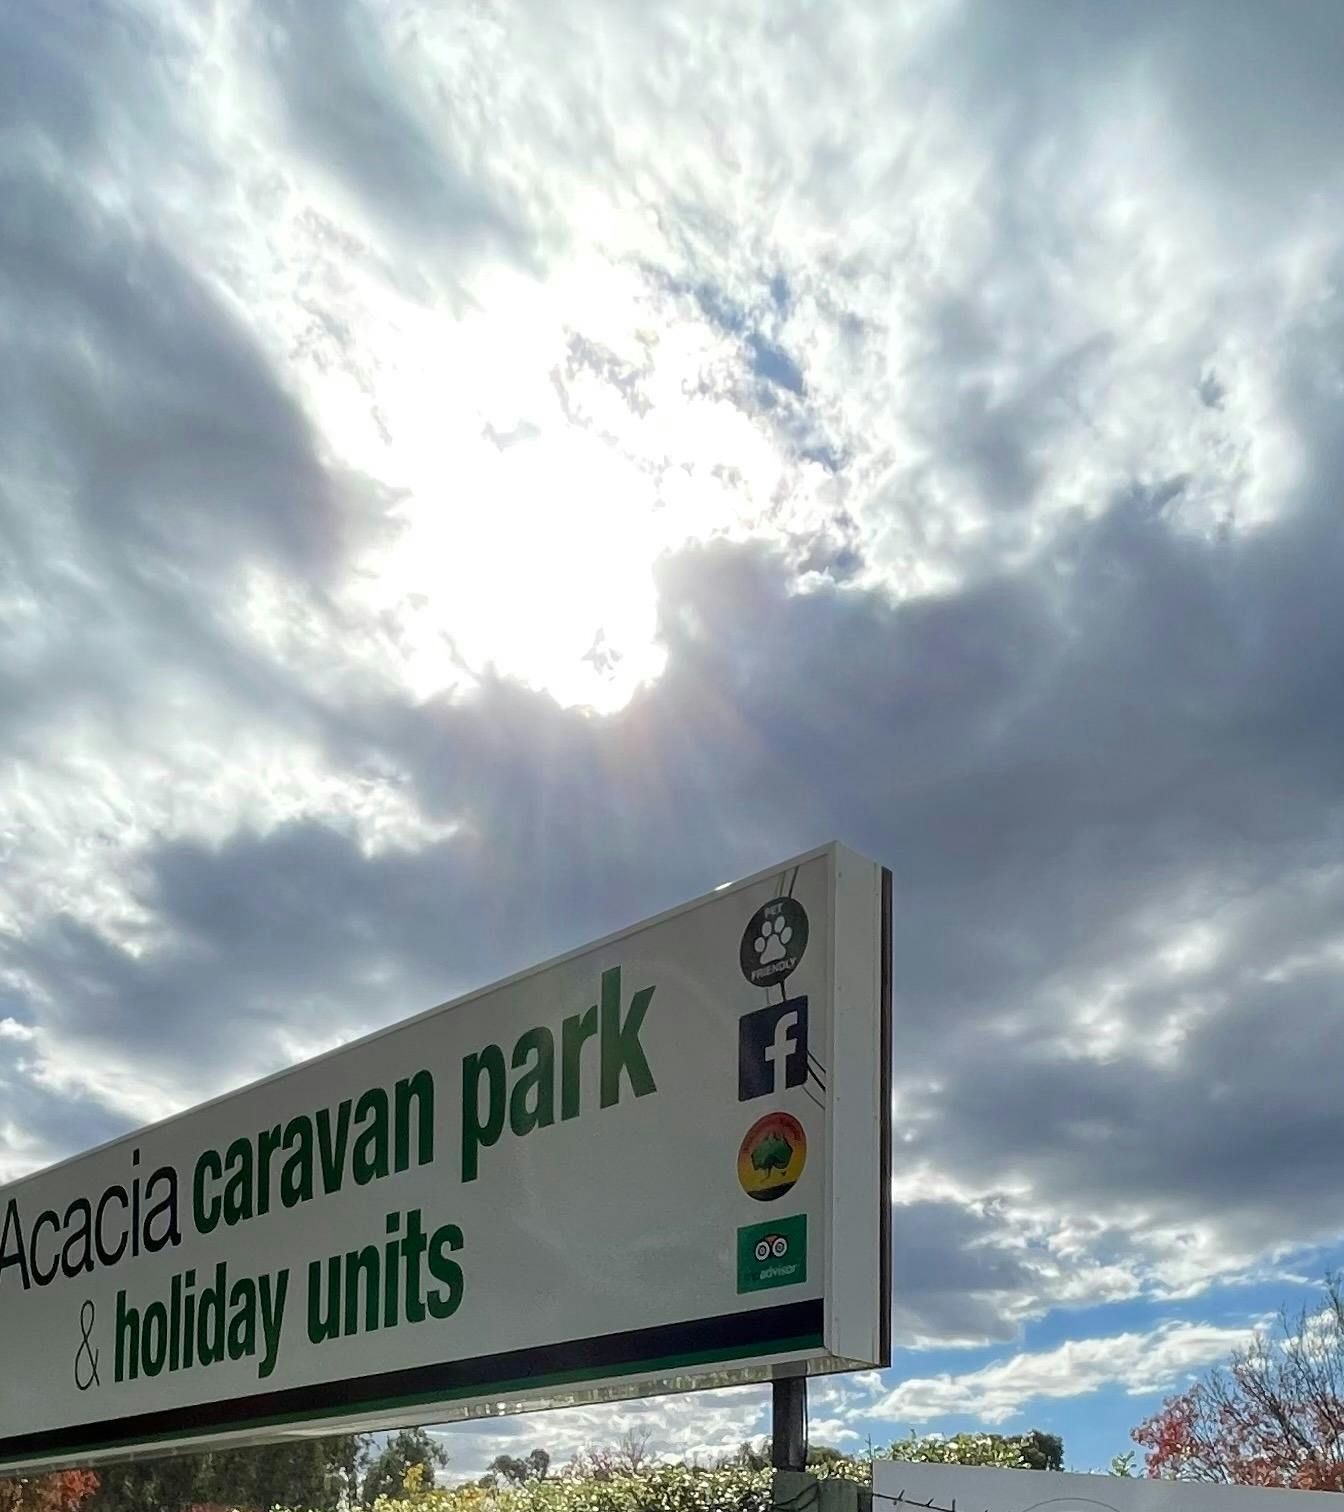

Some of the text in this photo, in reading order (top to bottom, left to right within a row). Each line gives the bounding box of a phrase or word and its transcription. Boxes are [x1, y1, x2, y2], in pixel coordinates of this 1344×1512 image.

[764, 903, 784, 918] PET
[751, 956, 797, 981] FRIENDLY
[193, 1069, 435, 1235] caravan
[461, 966, 657, 1184] park
[74, 1208, 465, 1391] & holiday units
